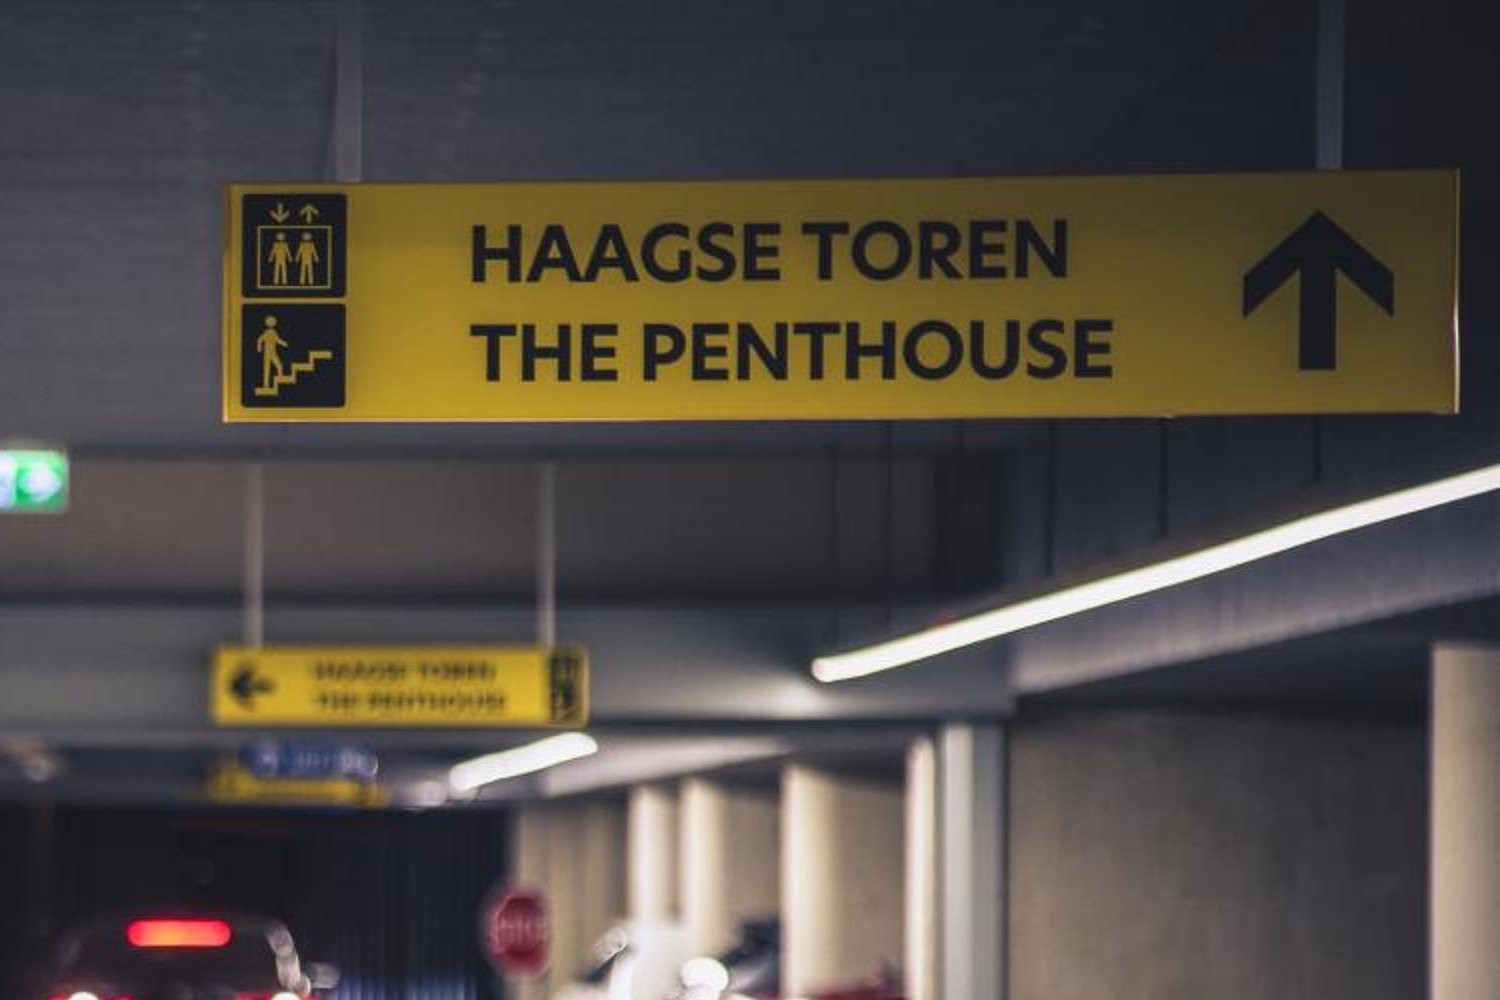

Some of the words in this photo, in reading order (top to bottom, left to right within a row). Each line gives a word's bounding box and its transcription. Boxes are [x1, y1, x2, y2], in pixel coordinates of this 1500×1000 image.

[471, 222, 782, 283] HAAGSE
[801, 219, 1067, 281] TOREN
[471, 324, 618, 382] THE
[644, 319, 1114, 381] PENTHOUSE
